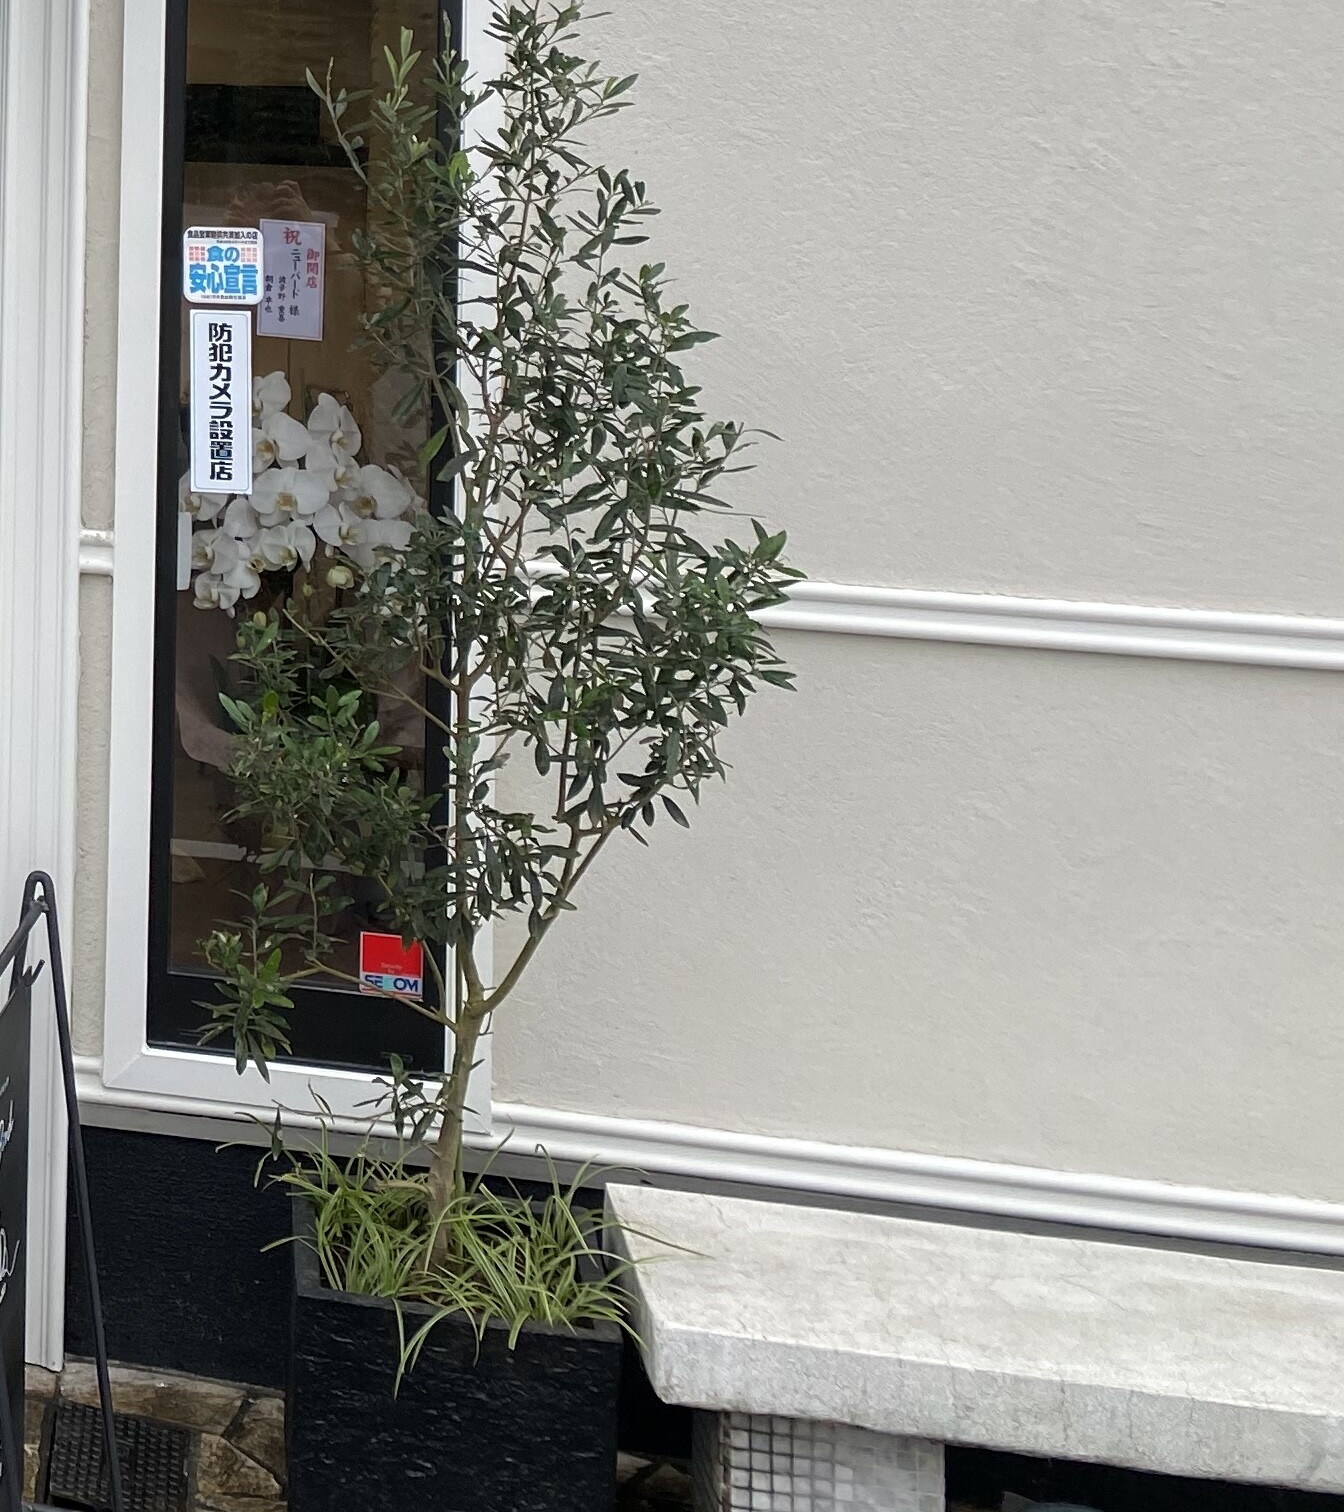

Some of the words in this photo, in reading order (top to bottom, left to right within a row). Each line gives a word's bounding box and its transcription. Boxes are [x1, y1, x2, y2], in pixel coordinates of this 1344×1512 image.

[283, 227, 302, 246] 祝
[206, 245, 241, 263] 食の
[189, 263, 259, 296] 安心宣言
[208, 321, 234, 482] 防犯カメラ設置店
[364, 974, 419, 993] SEOM
